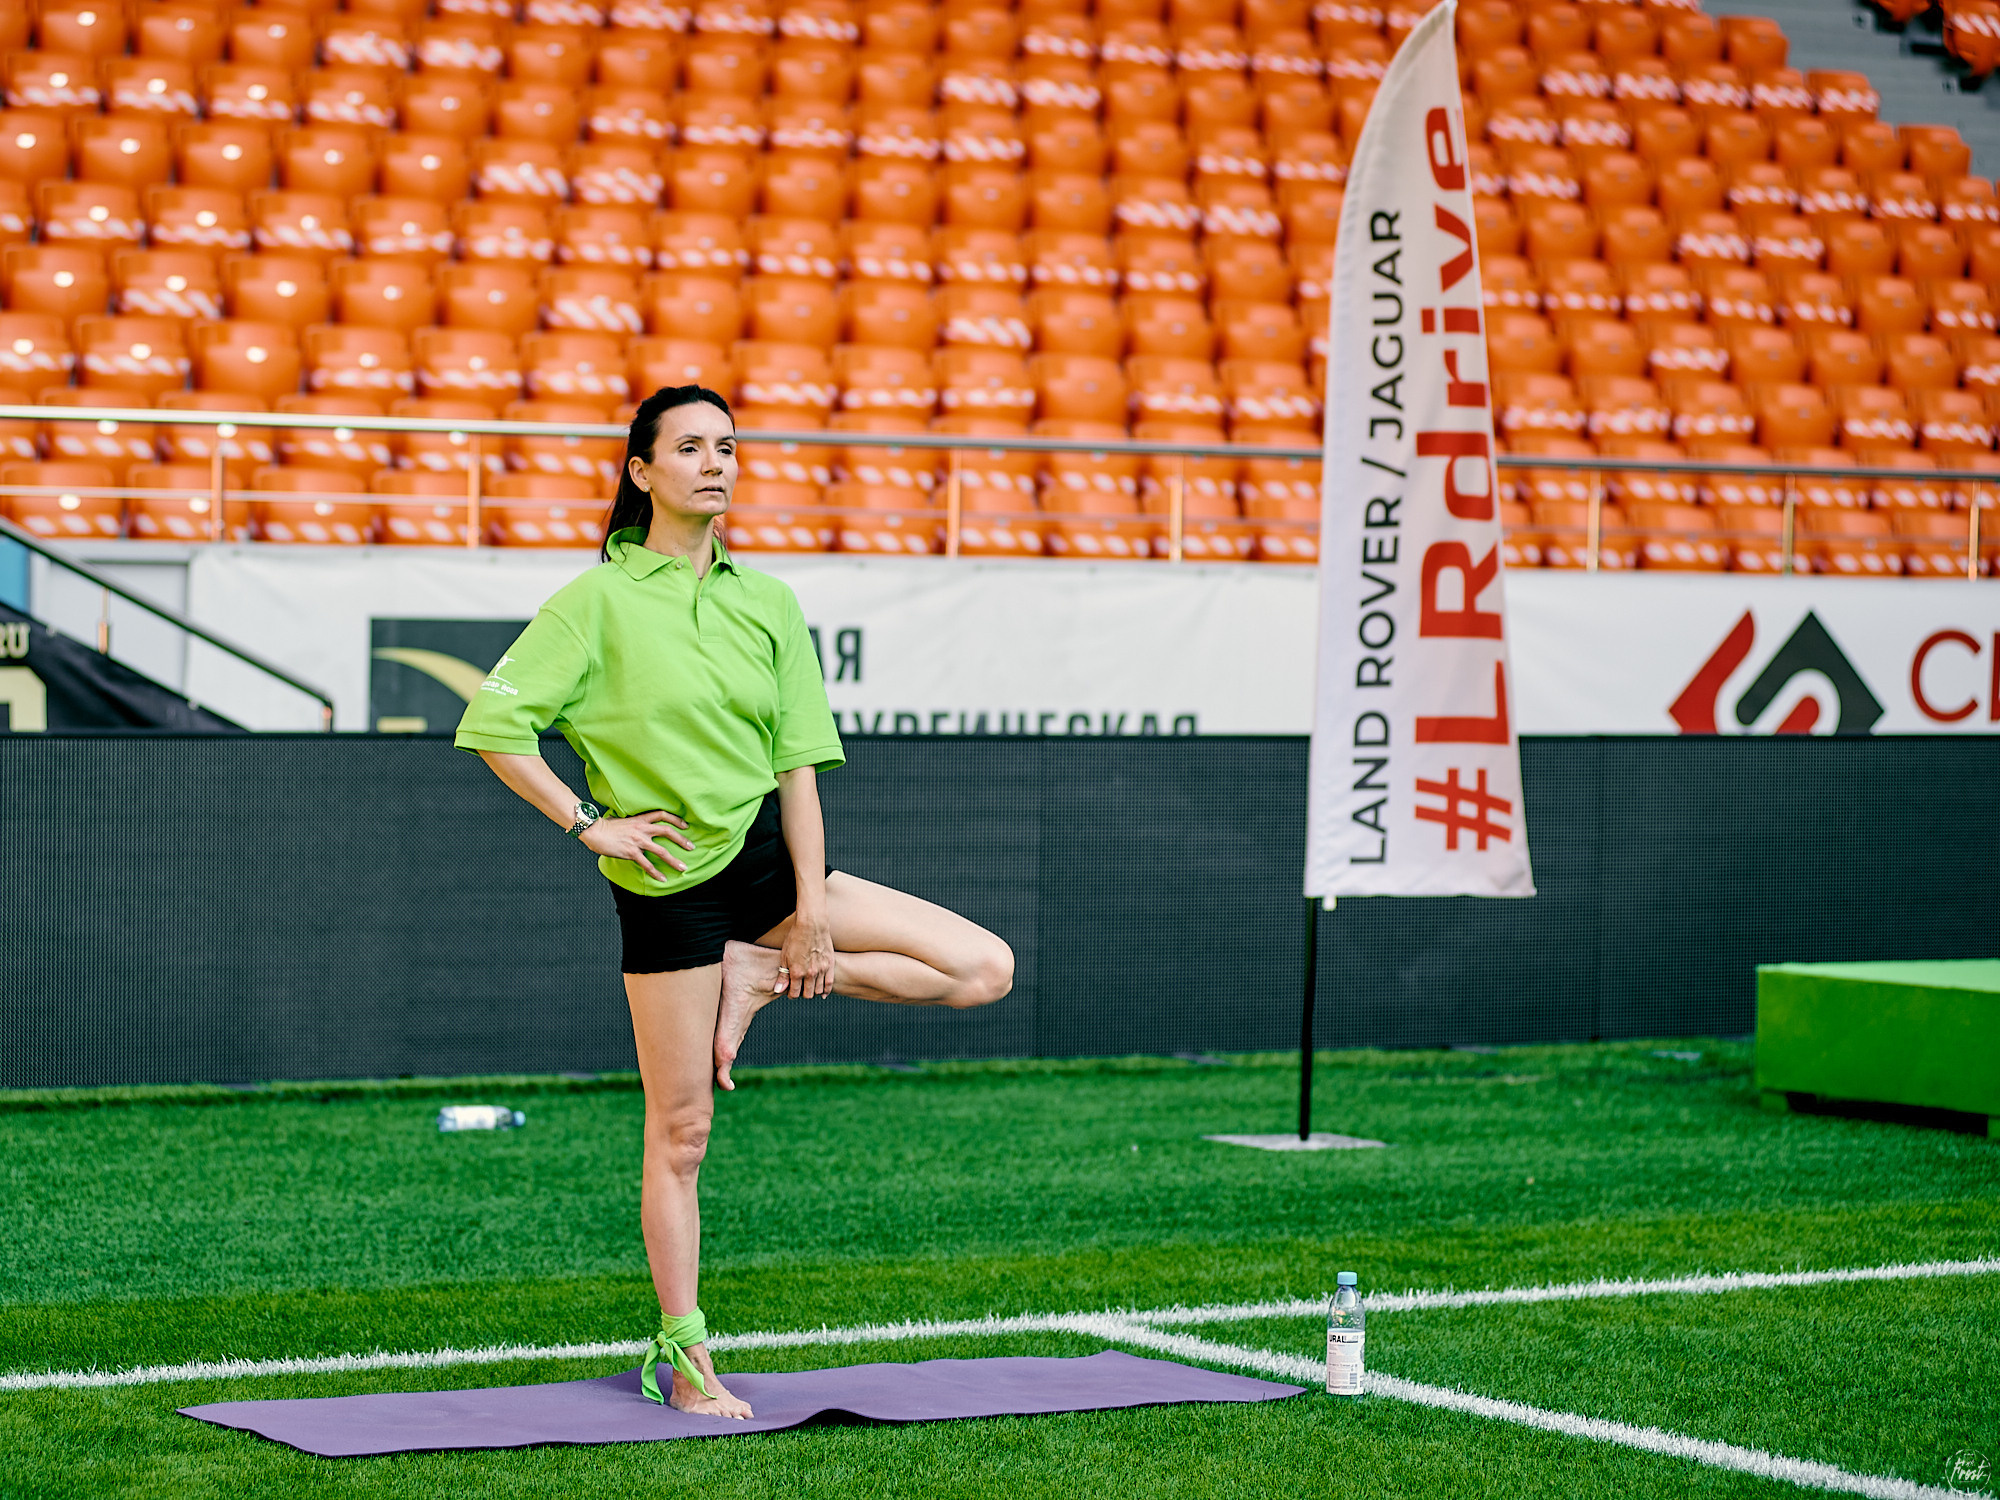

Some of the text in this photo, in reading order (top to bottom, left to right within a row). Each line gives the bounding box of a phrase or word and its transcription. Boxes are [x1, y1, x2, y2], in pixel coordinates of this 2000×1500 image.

[1370, 209, 1404, 440] JAGUAR
[1414, 106, 1513, 852] #LRdrive
[1356, 495, 1402, 688] ROVER
[1349, 710, 1391, 865] LAND
